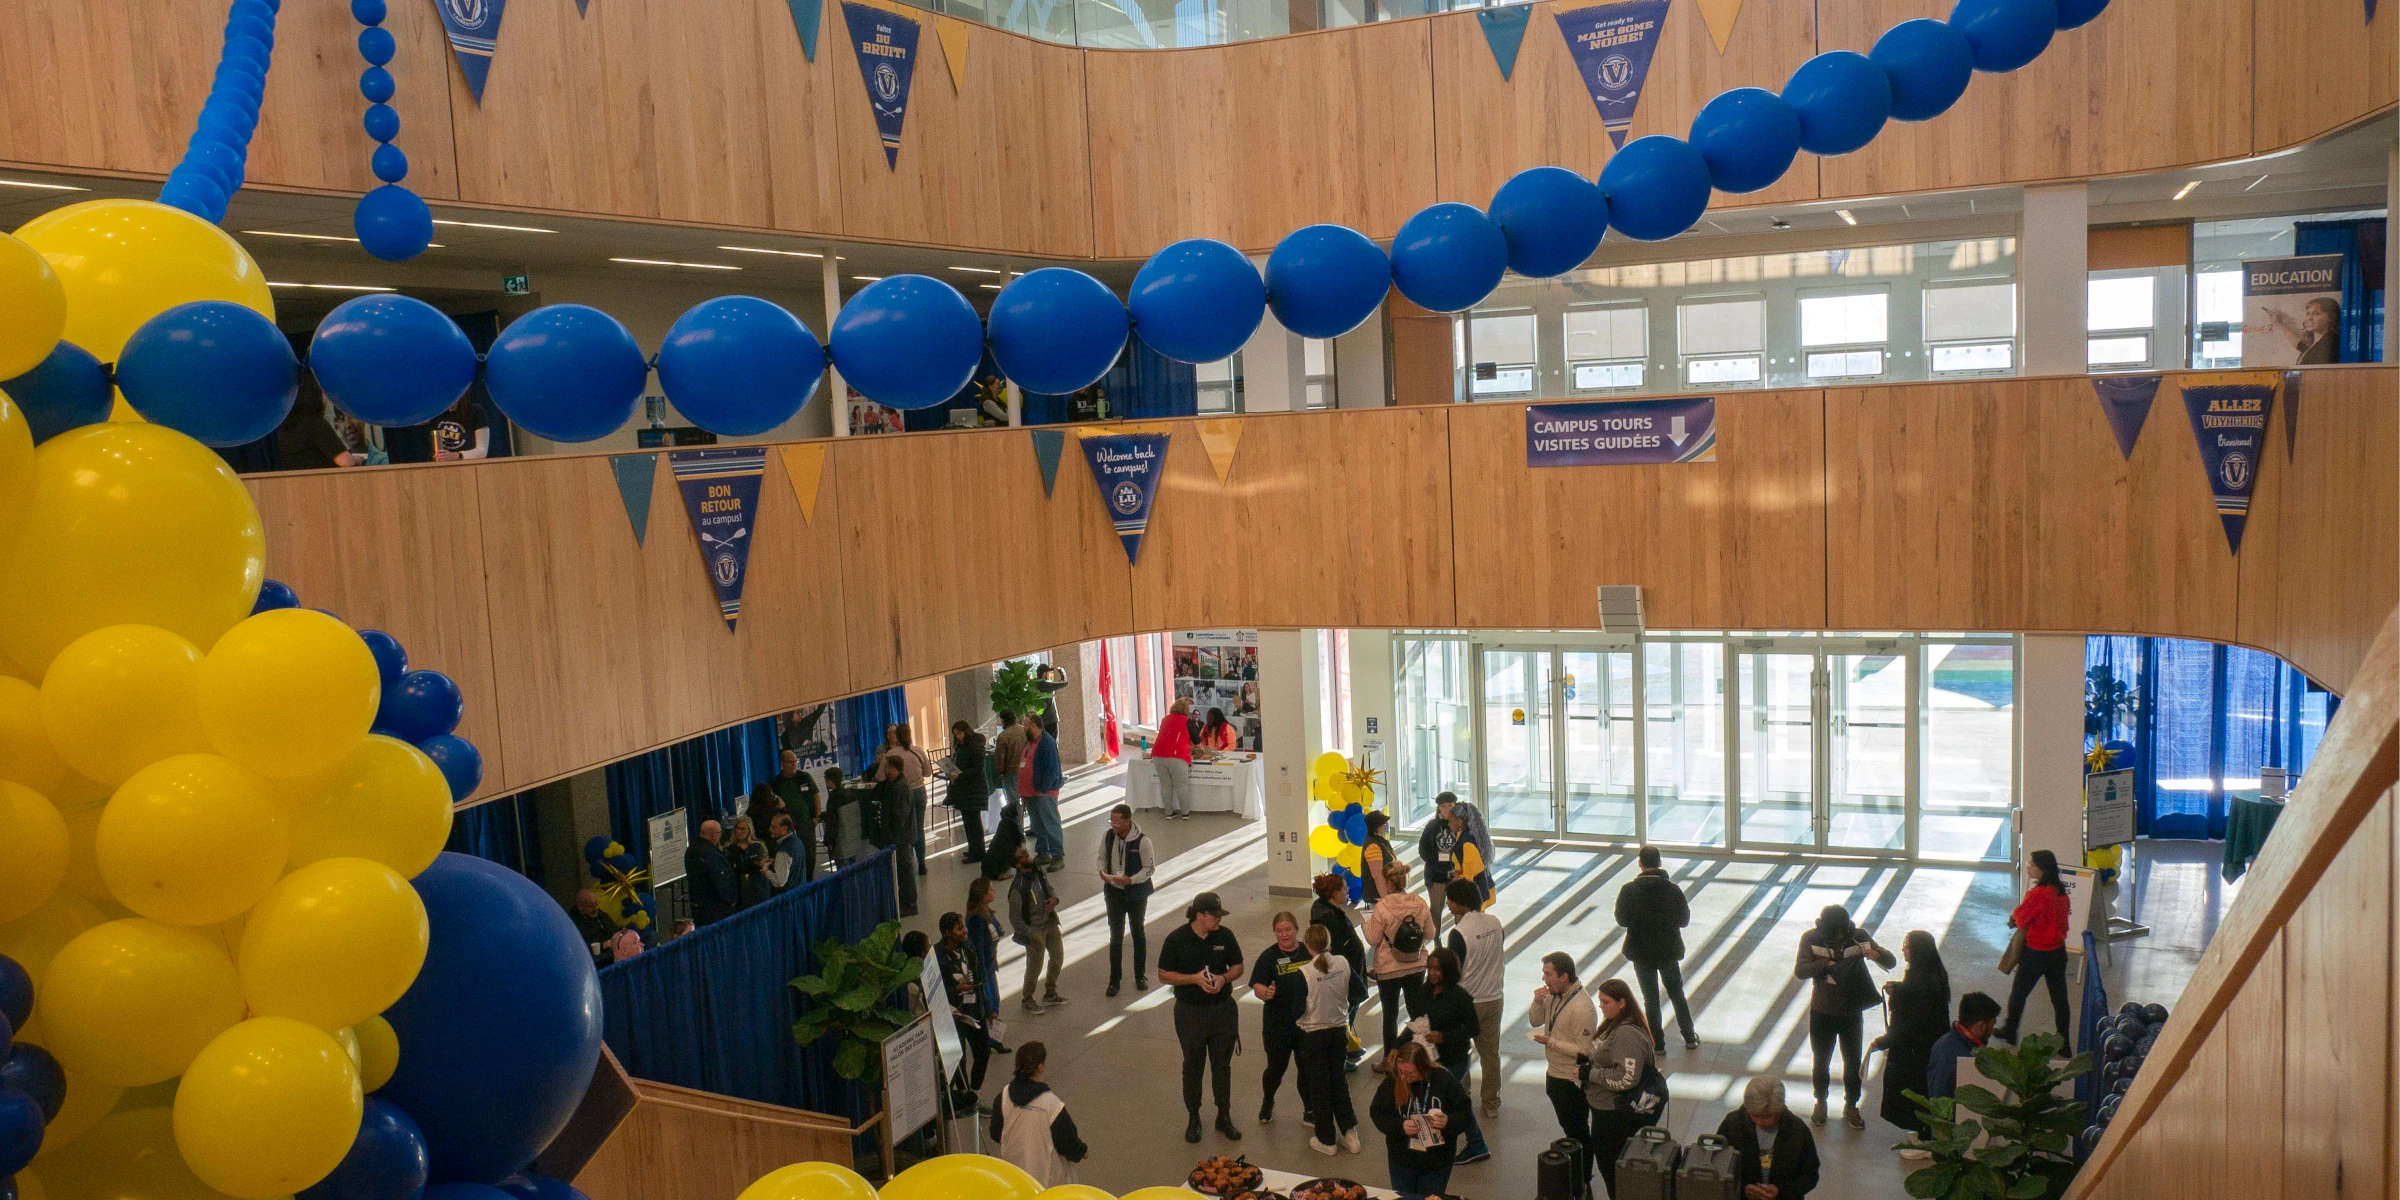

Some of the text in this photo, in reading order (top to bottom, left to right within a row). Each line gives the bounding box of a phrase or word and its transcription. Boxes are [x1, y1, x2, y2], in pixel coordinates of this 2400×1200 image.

[876, 24, 892, 34] Faites
[1594, 22, 1607, 30] Get
[1607, 17, 1626, 27] ready
[875, 33, 890, 44] DU
[1577, 20, 1655, 43] MAKE SOME
[1589, 30, 1645, 51] NOISE!
[862, 41, 906, 59] BRUIT!
[2250, 269, 2333, 286] EDUCATION
[2207, 399, 2262, 412] ALLEZ
[1533, 417, 1653, 434] CAMPUS TOURS
[2201, 414, 2264, 429] VOYAGEURS
[1534, 433, 1661, 452] VISITES GUIDÉES
[2217, 433, 2252, 448] Bienvenue!
[1096, 444, 1156, 463] Welcome back
[1103, 460, 1149, 478] to campus!
[708, 484, 731, 499] BON
[1118, 494, 1137, 504] LU
[701, 498, 741, 514] RETOUR
[702, 512, 743, 526] au campus!
[803, 756, 833, 770] Arts
